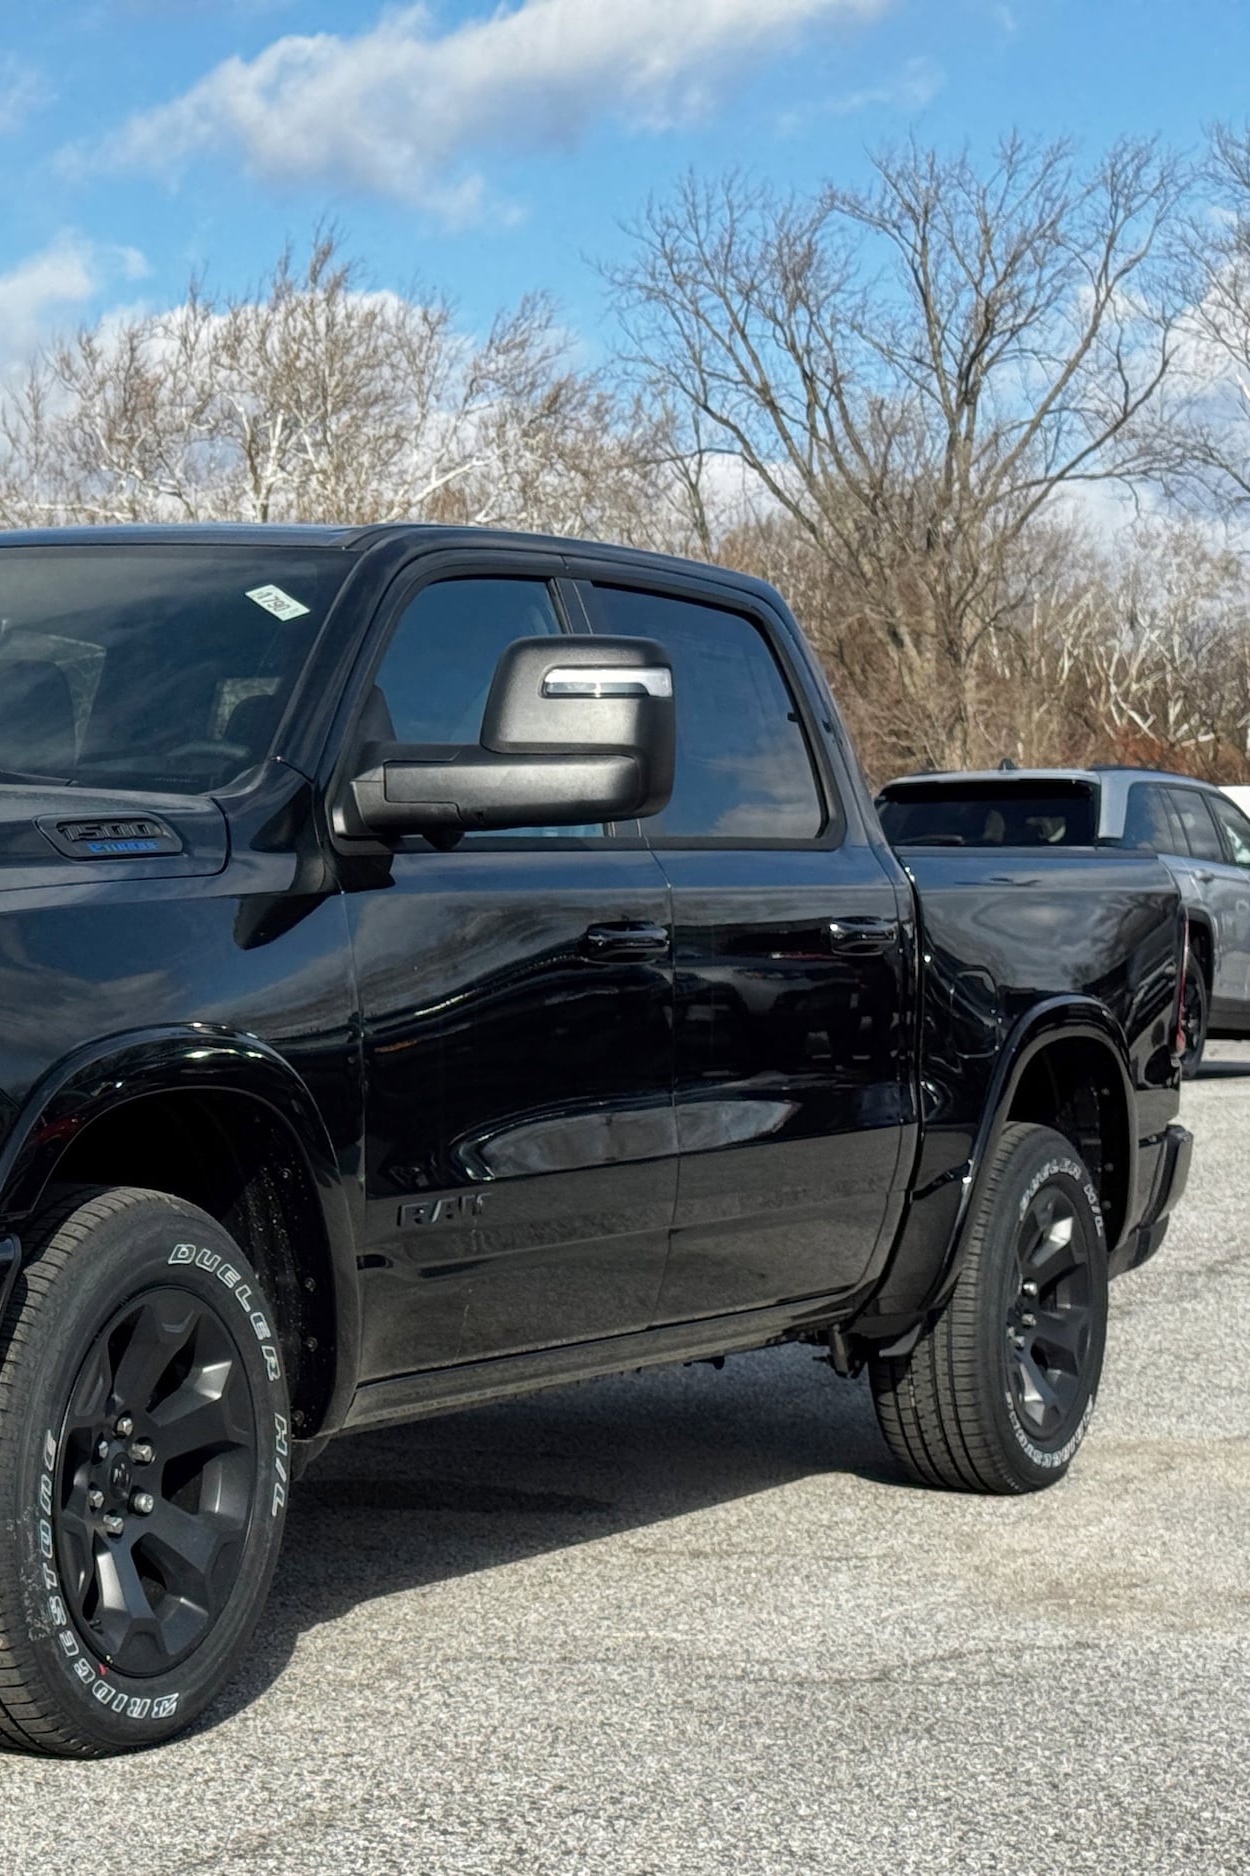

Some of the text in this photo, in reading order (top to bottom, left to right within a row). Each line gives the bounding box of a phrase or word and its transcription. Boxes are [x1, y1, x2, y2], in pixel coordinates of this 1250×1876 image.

[58, 821, 161, 842] 1500
[168, 1242, 289, 1518] DUELER H/L
[38, 1429, 181, 1721] BRIDGESTONE
